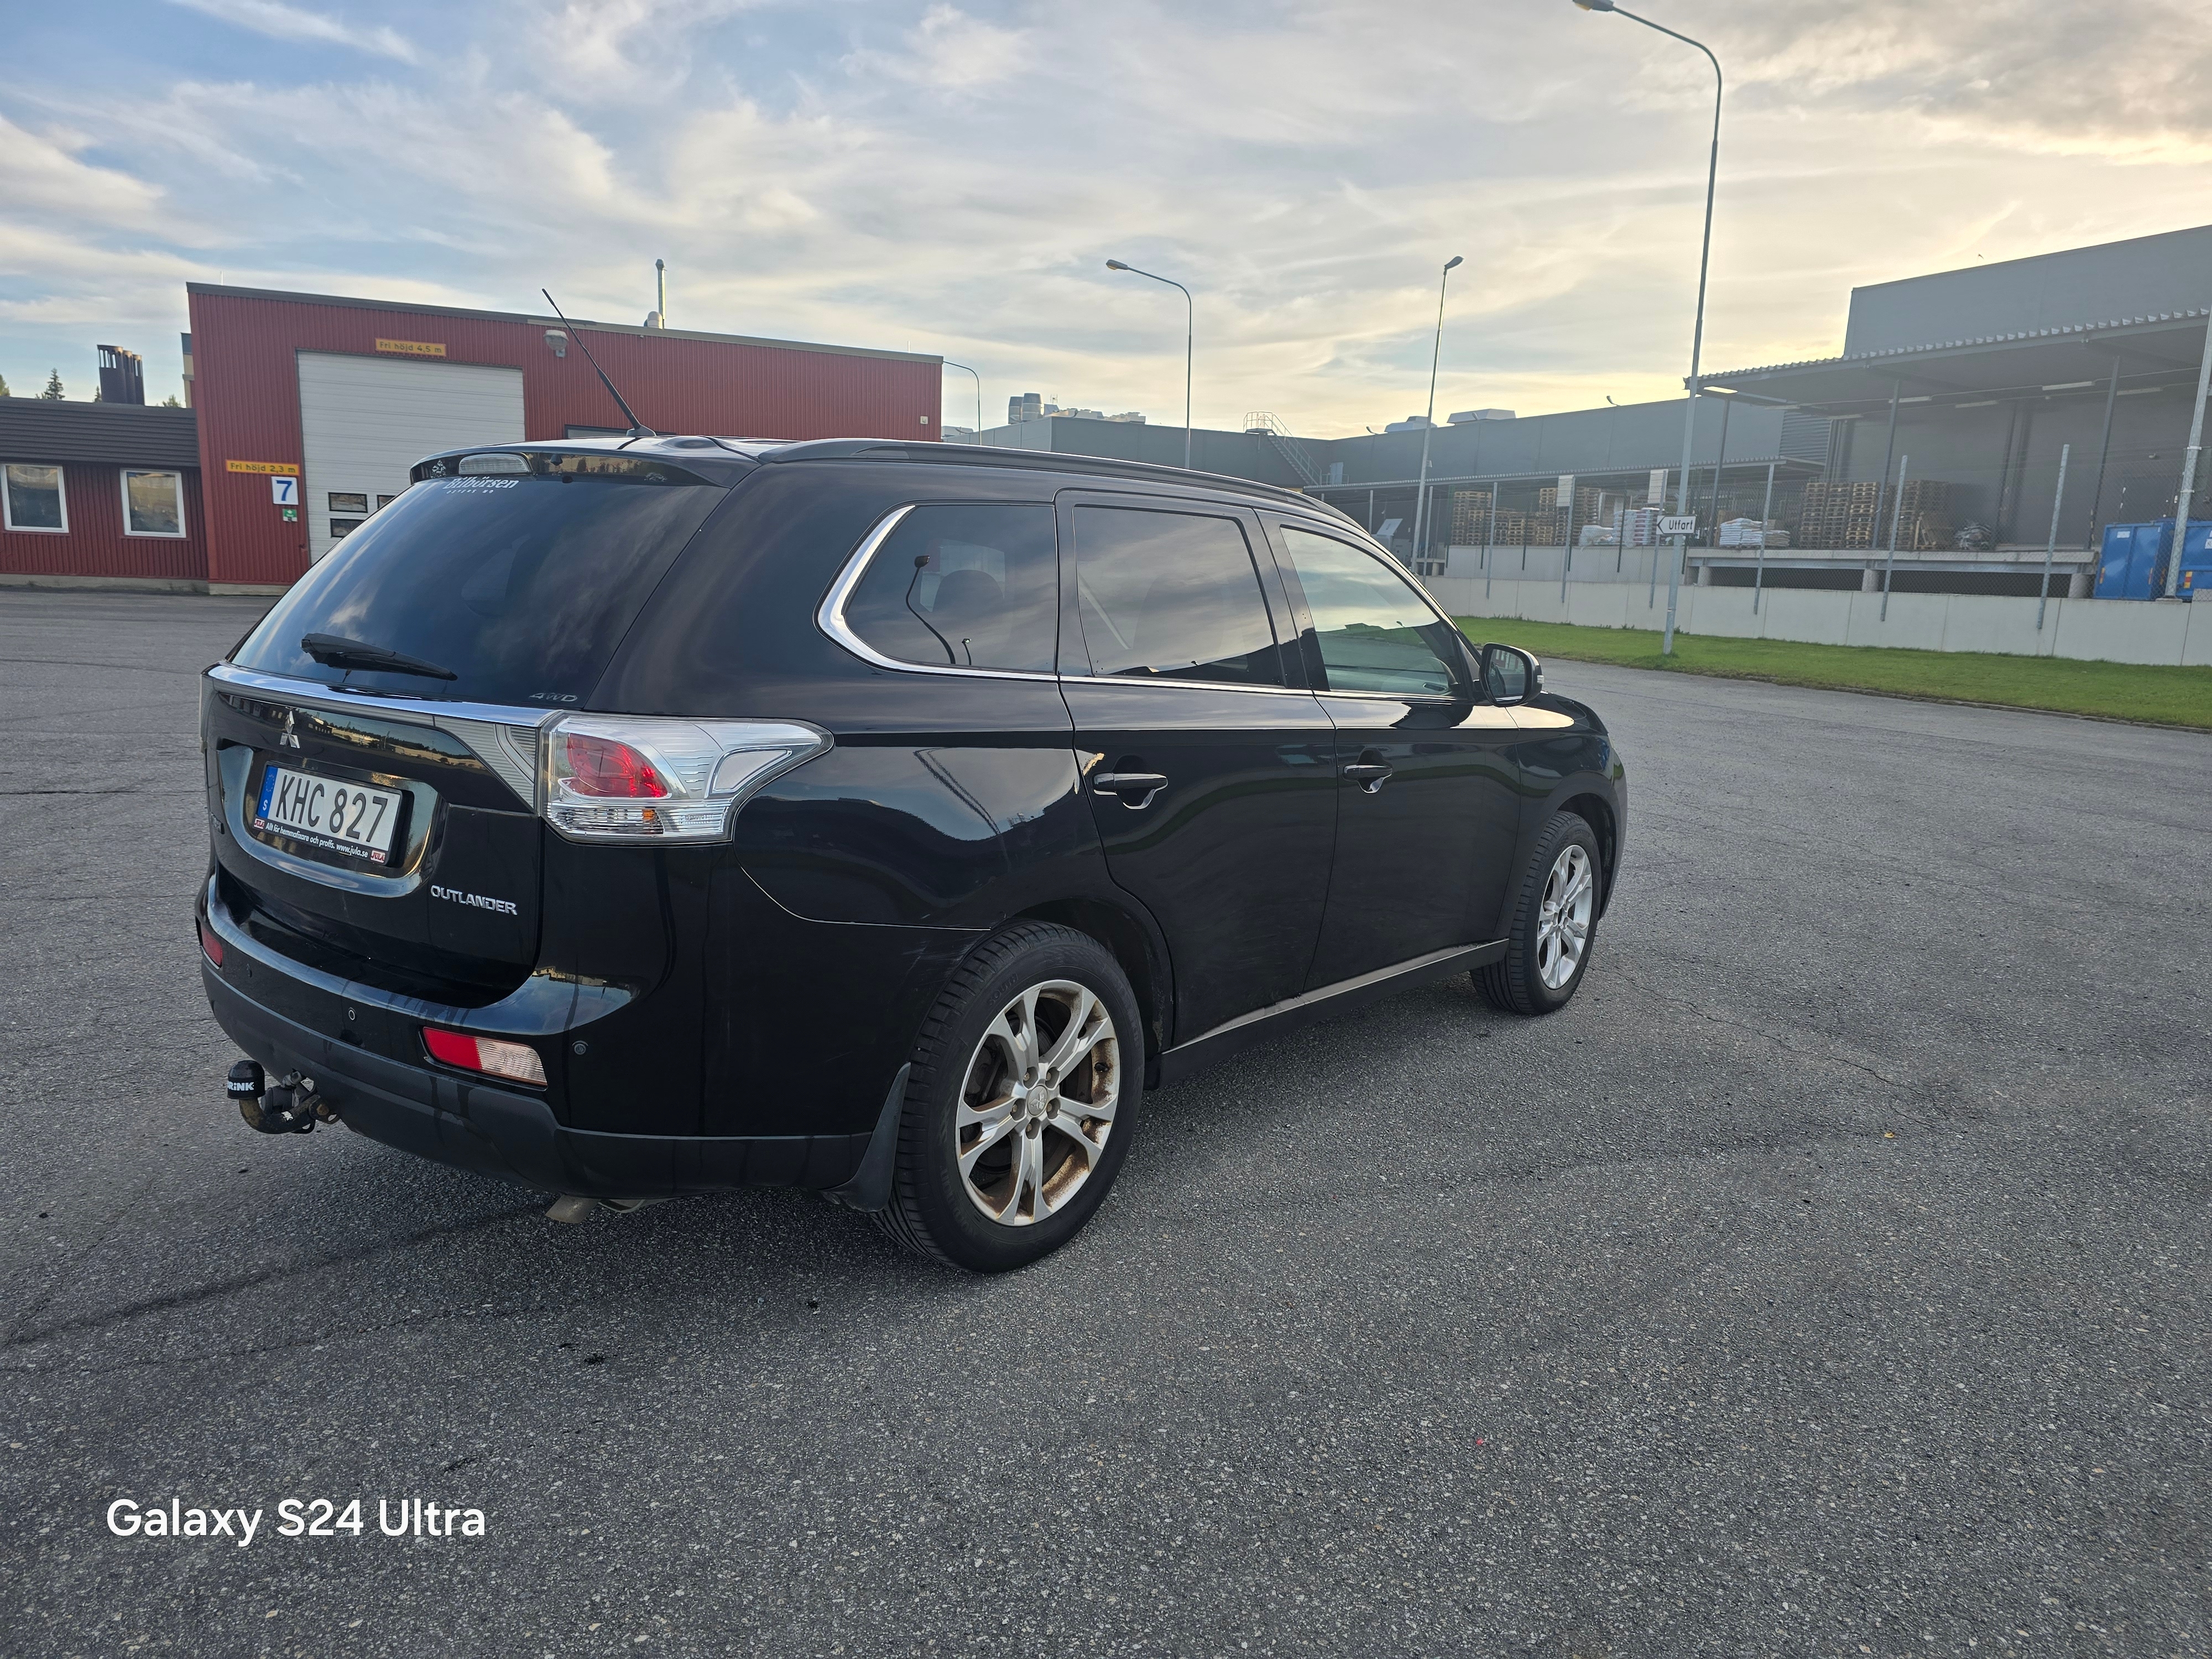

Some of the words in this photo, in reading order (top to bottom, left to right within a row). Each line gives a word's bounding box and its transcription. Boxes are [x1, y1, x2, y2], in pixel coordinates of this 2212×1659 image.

[394, 343, 414, 351] höjd
[417, 345, 431, 353] 4,5
[246, 464, 265, 472] höjd
[269, 465, 284, 473] 2,3
[275, 480, 293, 502] 7
[1669, 519, 1693, 530] Utfart
[529, 692, 578, 702] 4WD
[262, 799, 268, 811] S
[275, 775, 324, 827] KHC
[330, 789, 388, 842] 827
[280, 826, 310, 842] hemmafixare
[310, 836, 319, 844] och
[336, 843, 368, 858] www.jula.se
[372, 853, 385, 862] JULA
[430, 885, 518, 915] OUTLANDER
